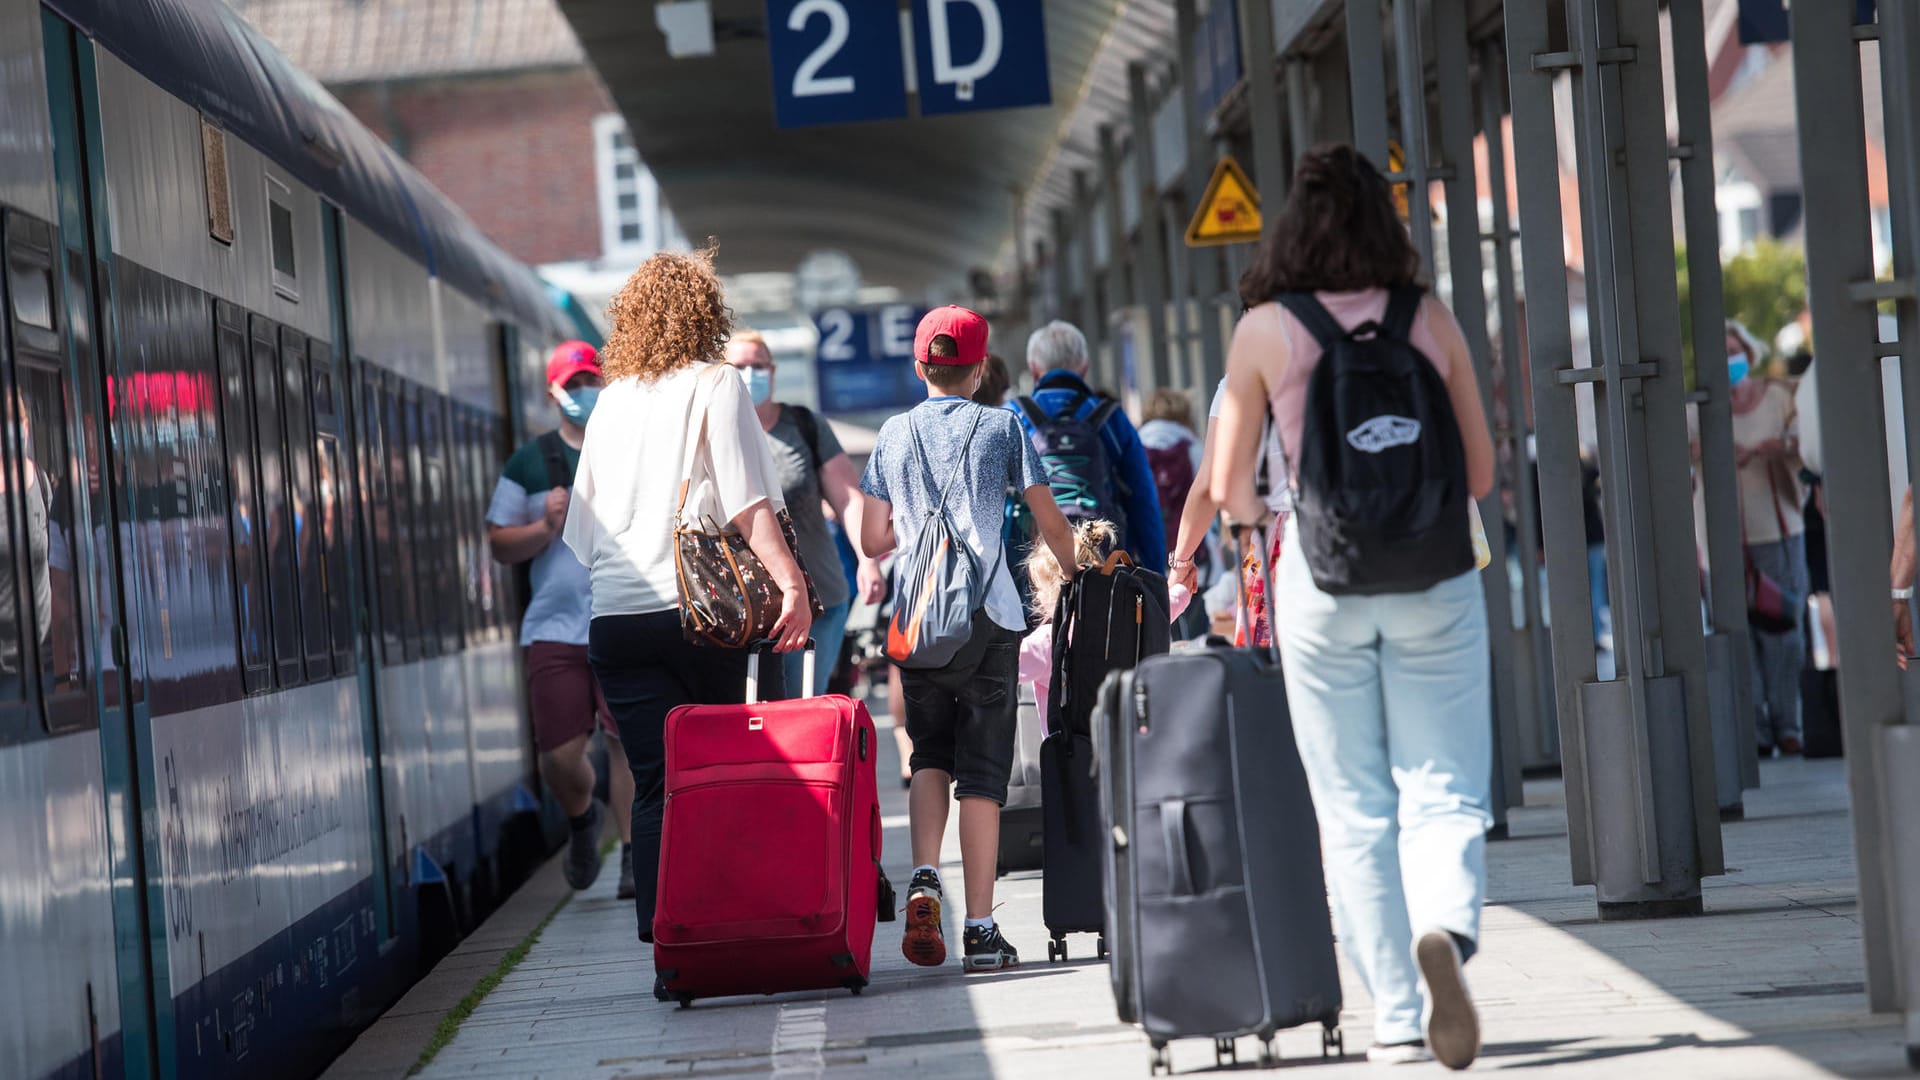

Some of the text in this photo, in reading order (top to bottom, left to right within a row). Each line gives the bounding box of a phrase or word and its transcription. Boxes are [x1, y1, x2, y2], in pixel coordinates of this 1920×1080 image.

[787, 0, 1003, 97] 2 D
[820, 305, 914, 362] 2 E
